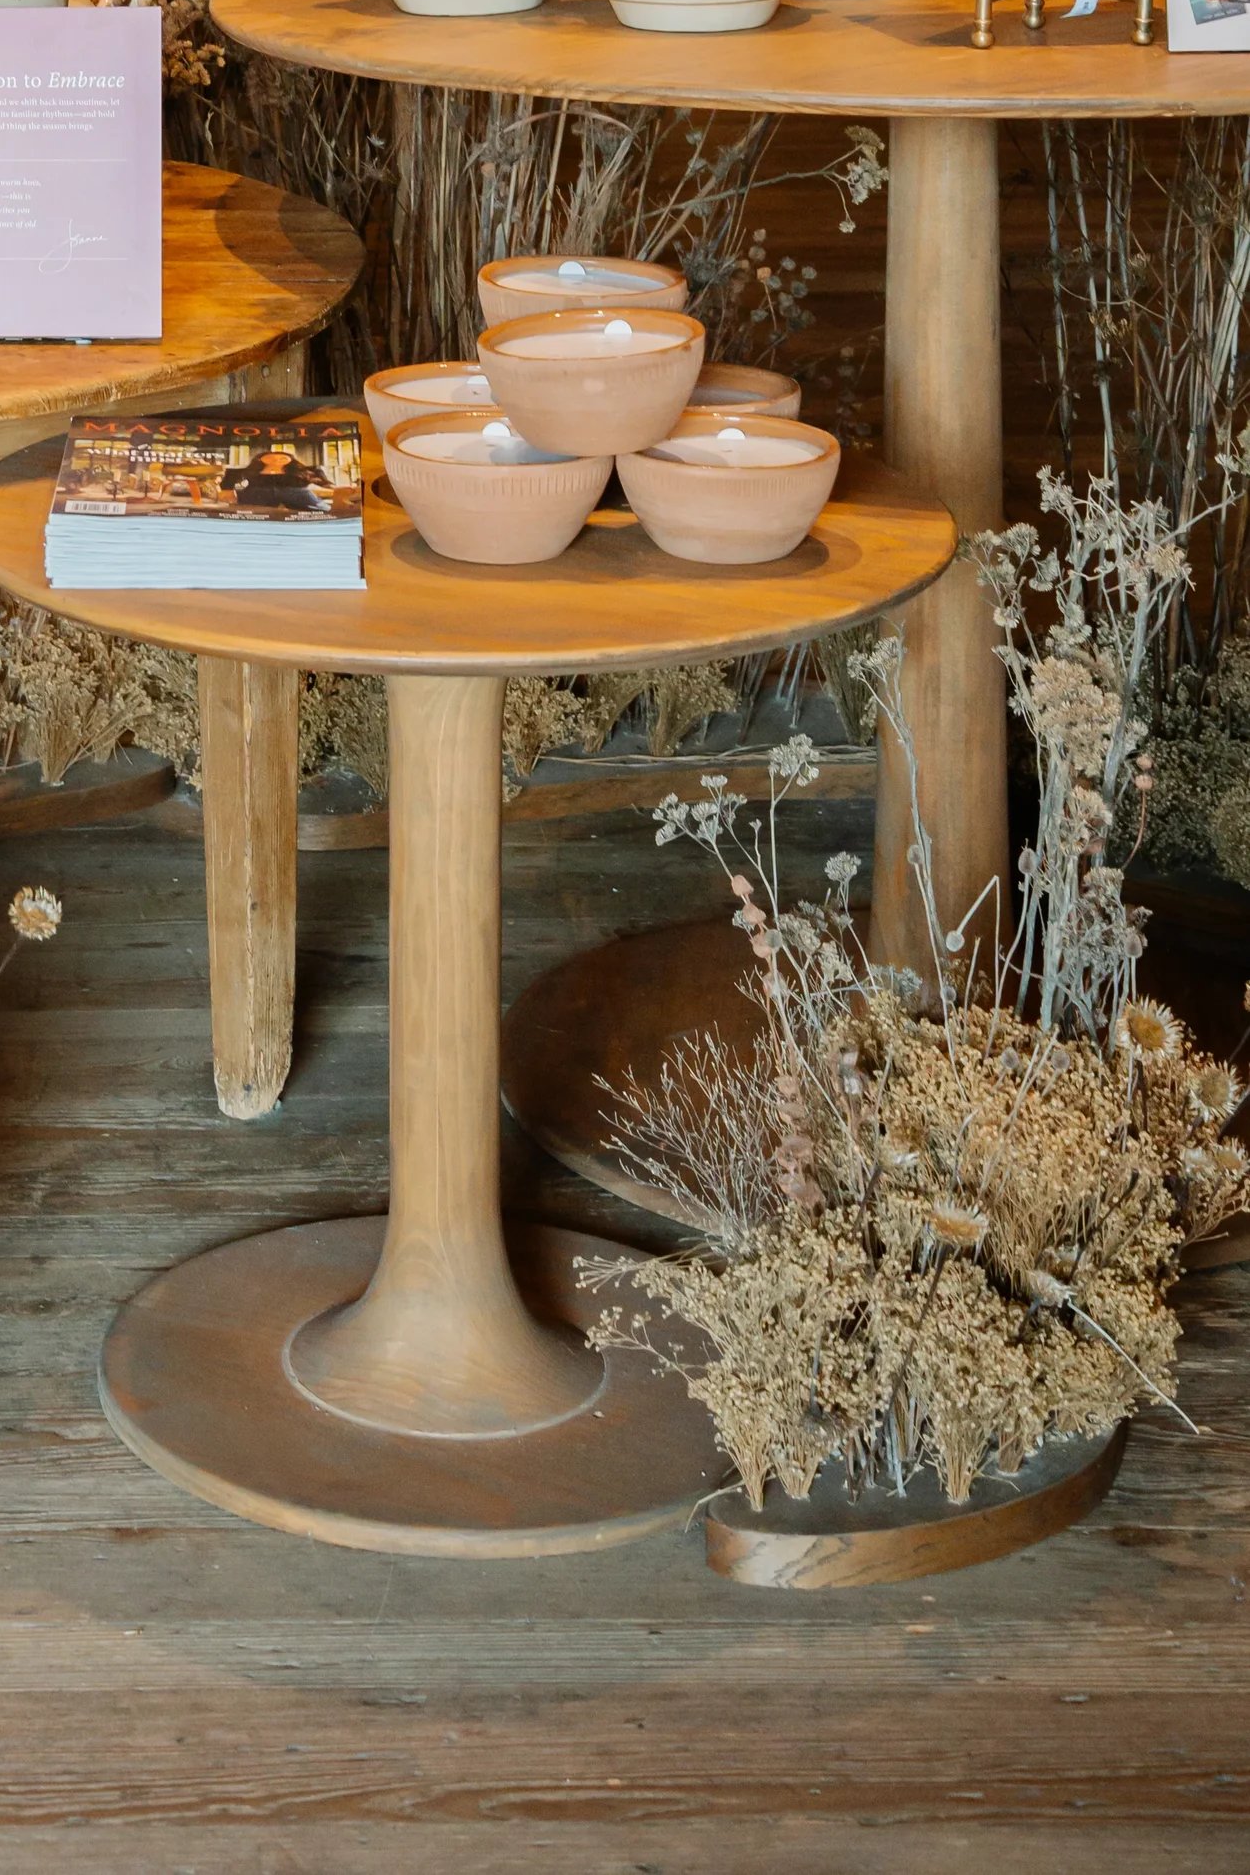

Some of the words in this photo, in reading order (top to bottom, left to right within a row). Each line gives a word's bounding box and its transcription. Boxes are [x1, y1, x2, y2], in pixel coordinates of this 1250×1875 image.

[24, 73, 42, 89] to
[47, 70, 125, 89] Embrace
[20, 97, 37, 106] shift
[39, 97, 57, 106] back
[110, 97, 120, 106] let
[11, 109, 40, 118] familiar
[98, 109, 116, 118] hold
[6, 121, 27, 132] thing
[28, 121, 41, 130] the
[0, 179, 21, 187] warm
[16, 208, 31, 217] you
[25, 220, 37, 228] old
[83, 421, 347, 437] MAGNOLIA
